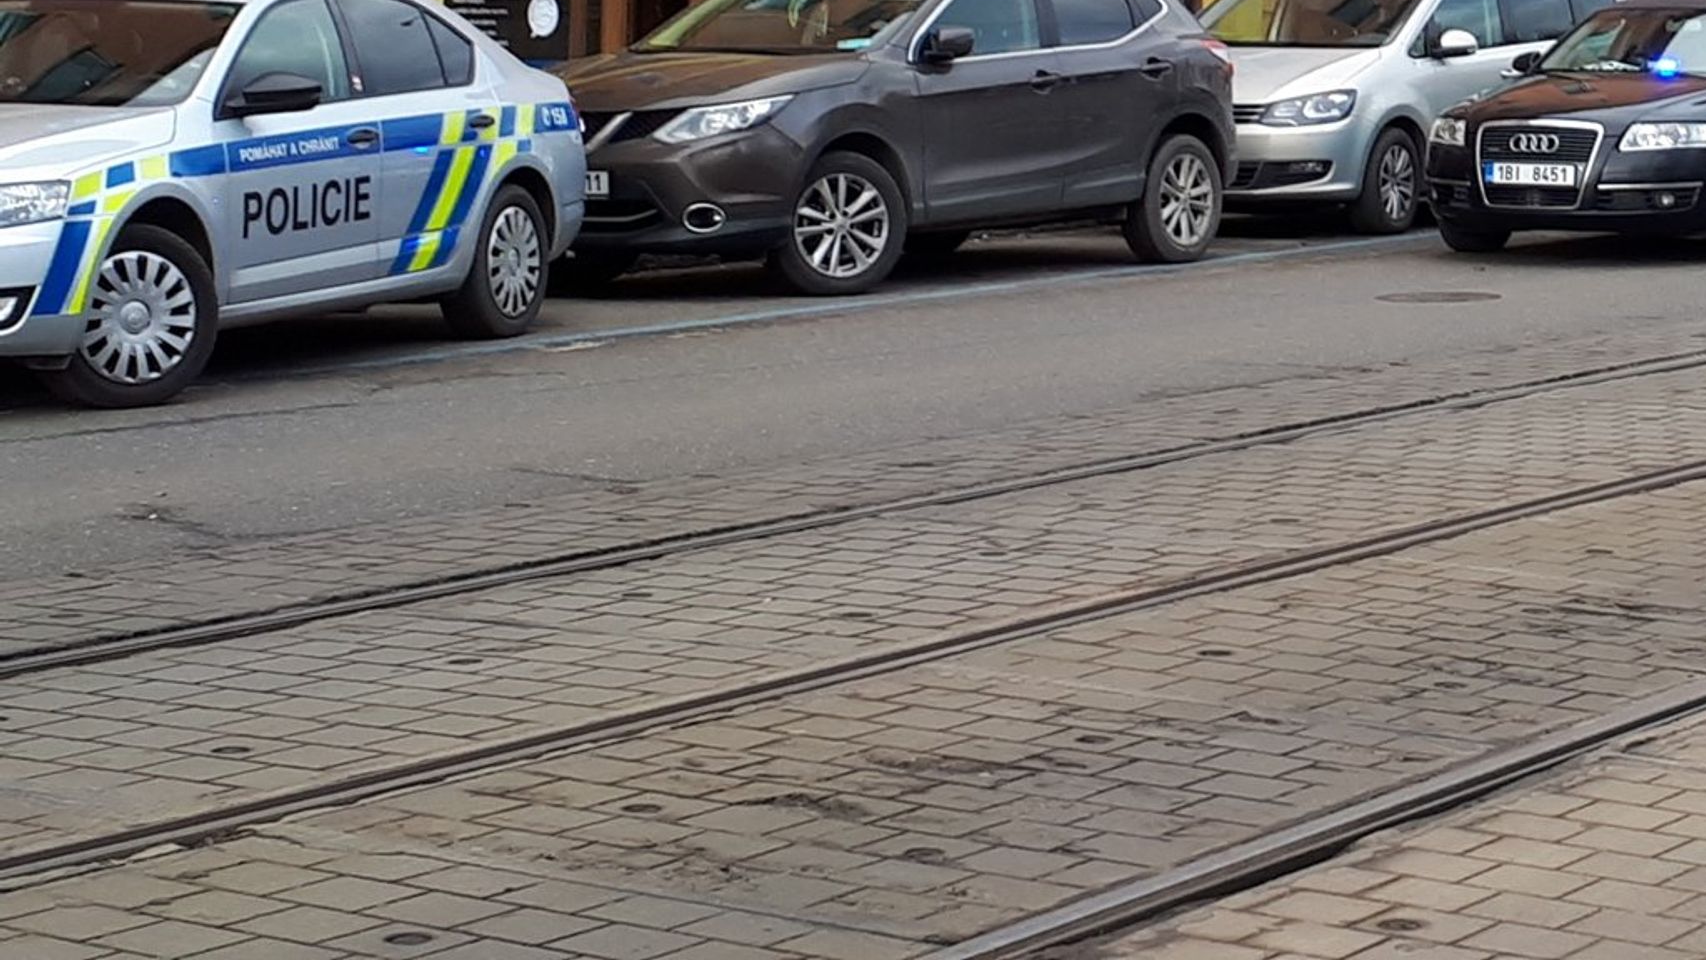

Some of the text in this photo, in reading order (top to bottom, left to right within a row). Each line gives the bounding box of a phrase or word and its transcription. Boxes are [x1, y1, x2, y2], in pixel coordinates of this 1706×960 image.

[239, 135, 340, 163] POMÁHAT A CHRÁNIT
[1532, 166, 1567, 182] 8451
[241, 175, 372, 240] POLICIE
